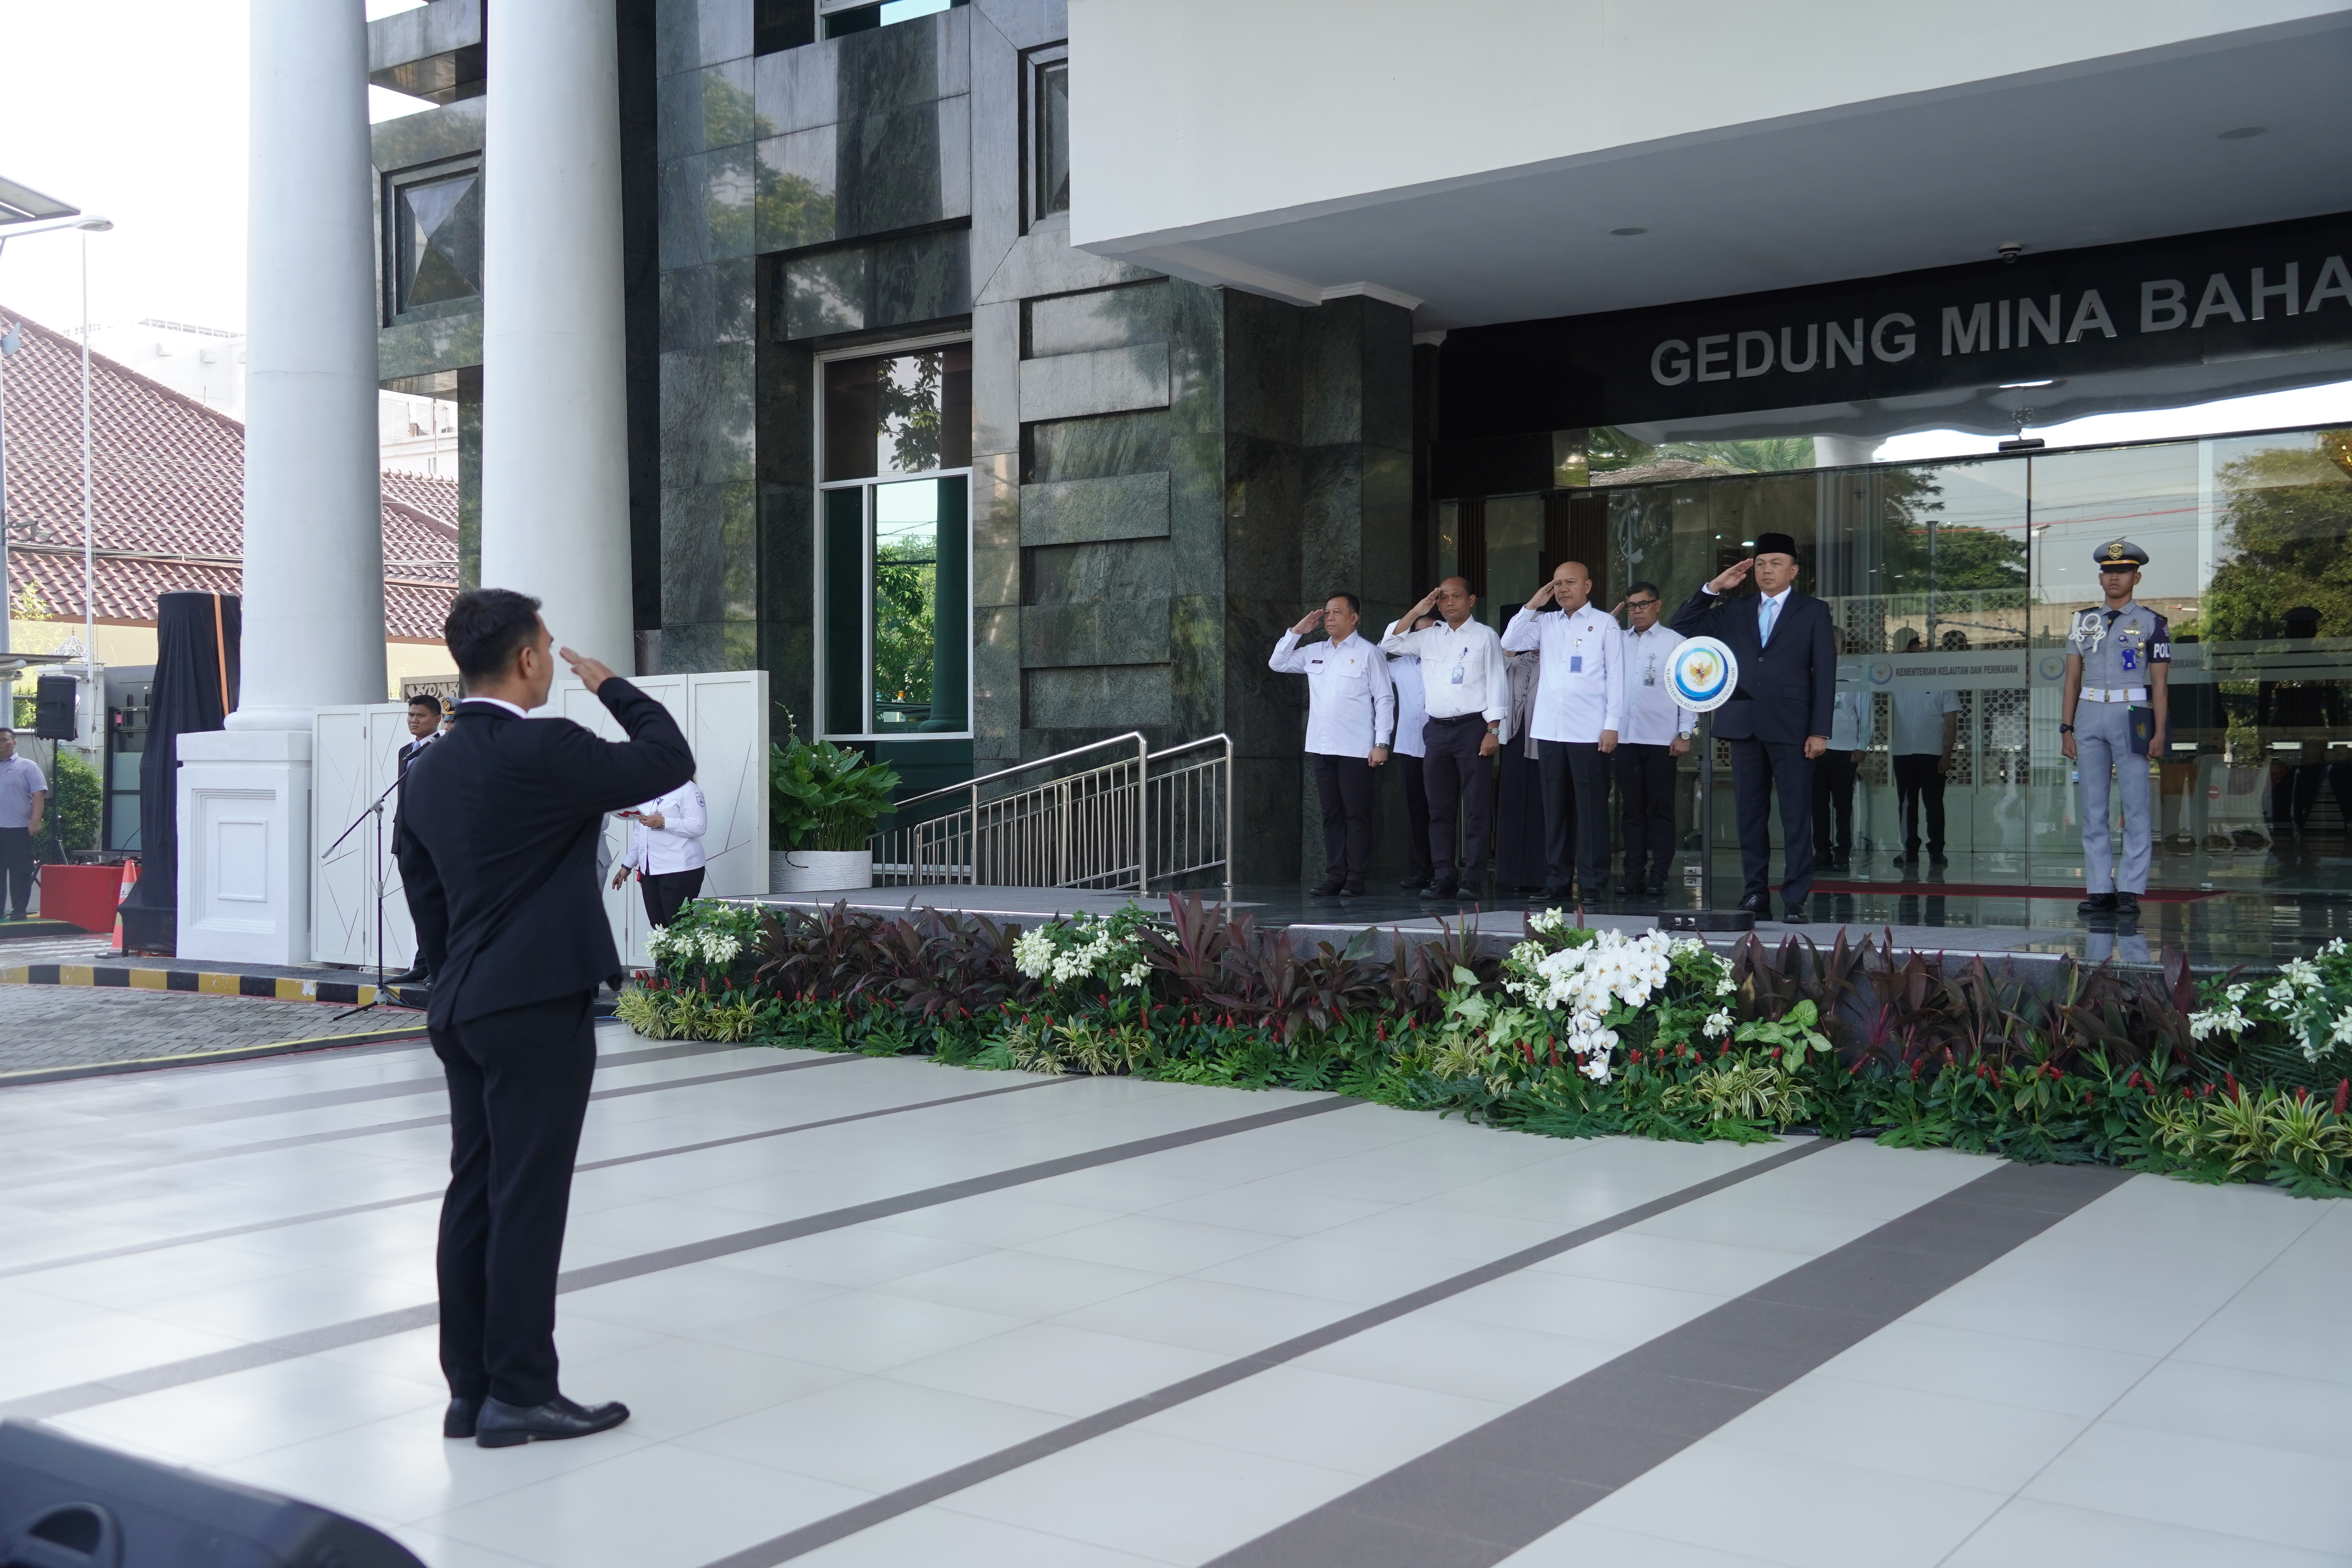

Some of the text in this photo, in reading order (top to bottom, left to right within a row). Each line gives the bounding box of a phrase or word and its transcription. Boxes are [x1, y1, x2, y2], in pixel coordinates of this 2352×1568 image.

[1650, 255, 2352, 386] GEDUNG MINA BAHA
[1666, 668, 1735, 710] KEMENTERIAN KELAUTAN DAN PERIKANAN
[1896, 665, 2018, 676] KEMENTERIAN KELAUTAN DAN PERIKANAN
